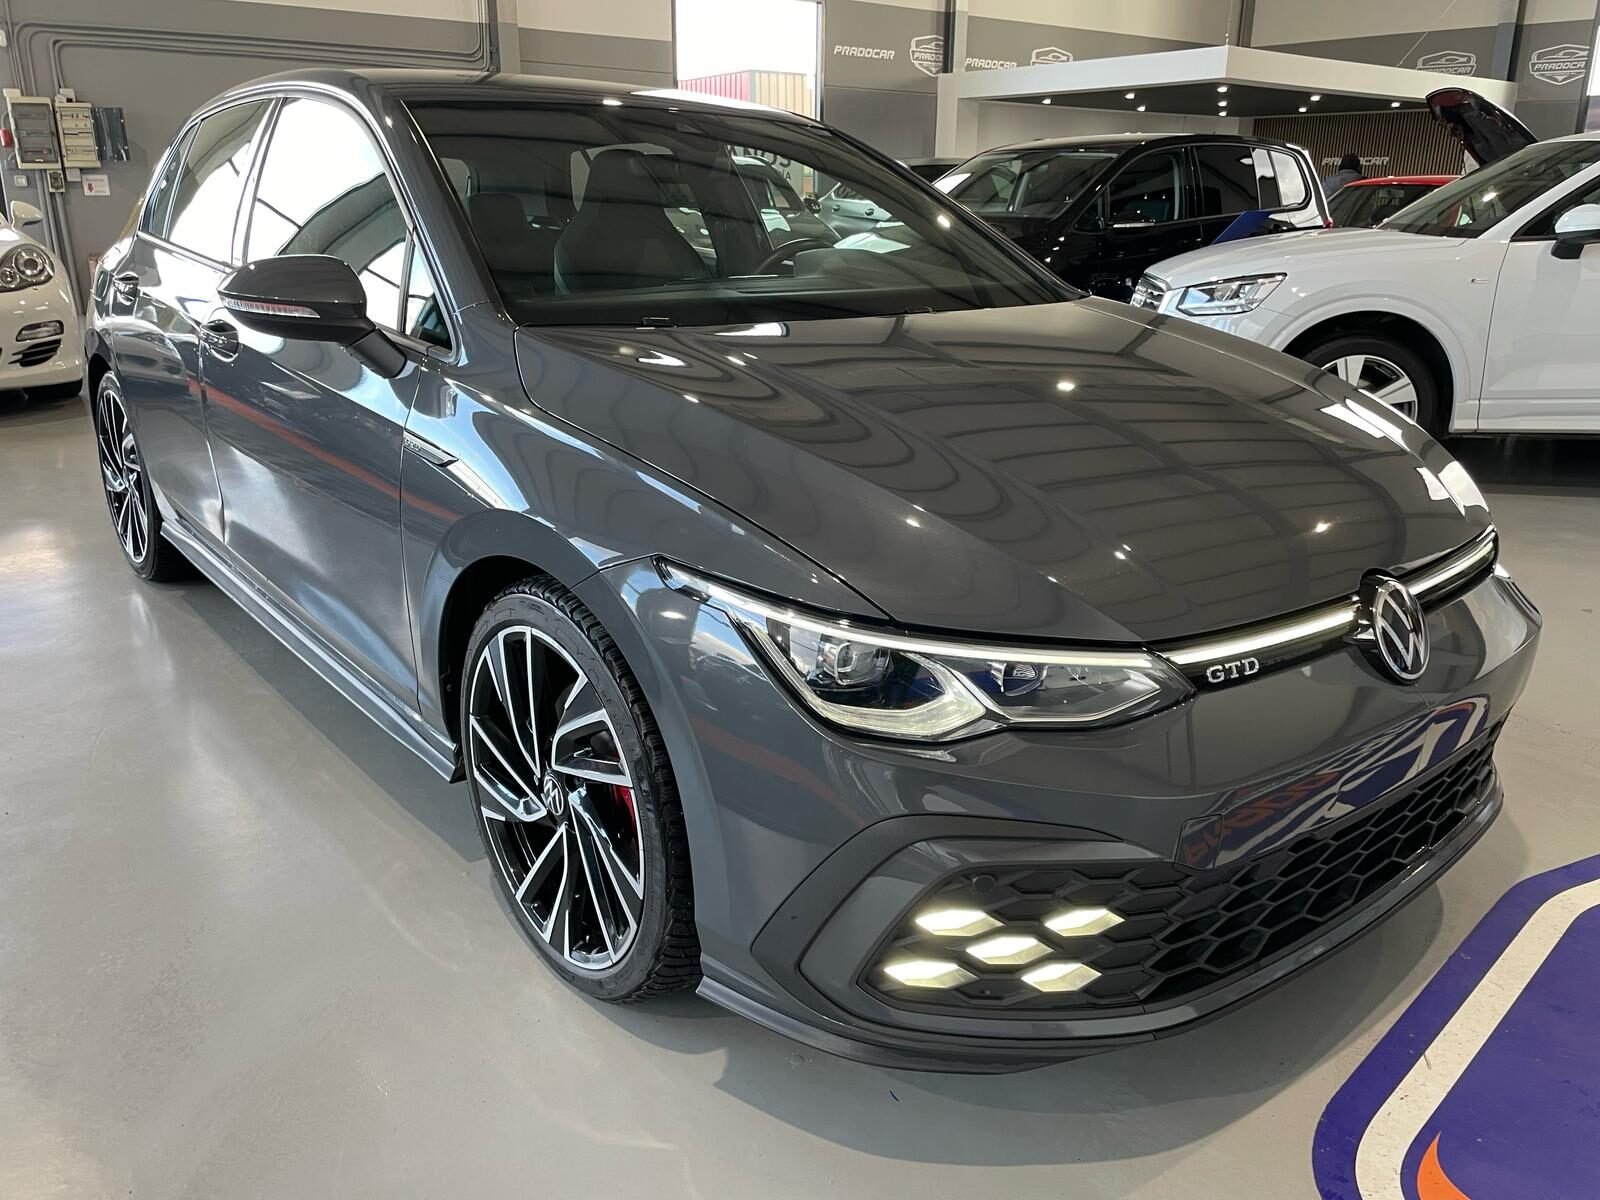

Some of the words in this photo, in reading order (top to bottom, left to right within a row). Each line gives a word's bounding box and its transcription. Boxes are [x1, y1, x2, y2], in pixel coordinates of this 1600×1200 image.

[833, 44, 896, 61] PRADOCAR
[913, 52, 944, 62] PRADO
[1533, 61, 1586, 71] PRADOCA
[1206, 656, 1260, 684] GTD
